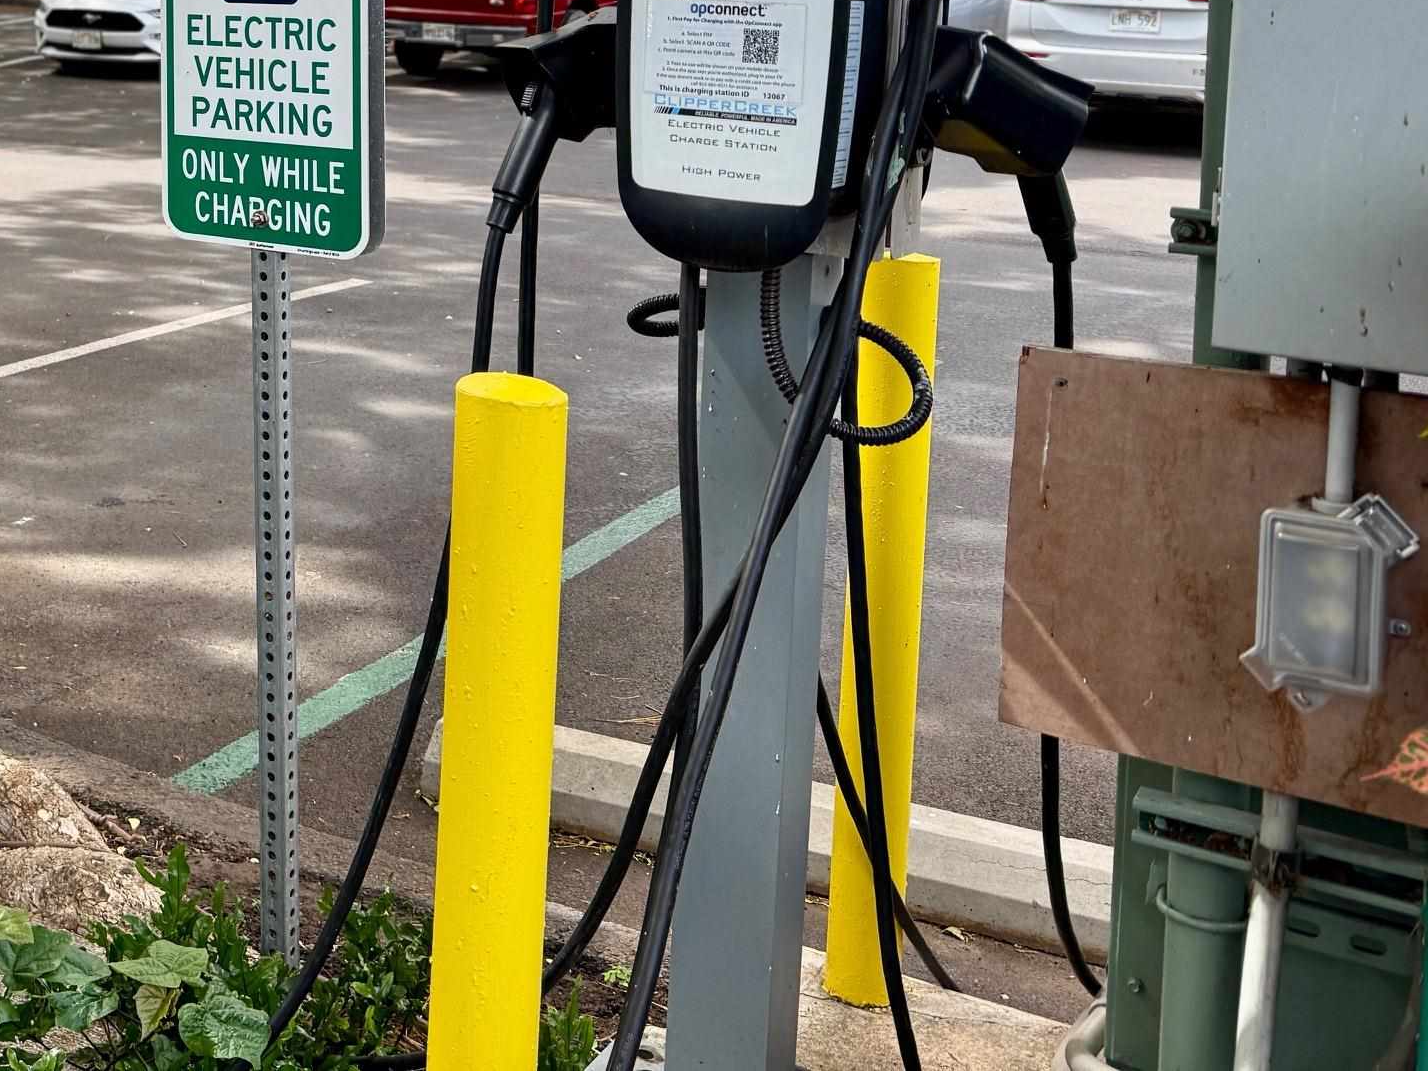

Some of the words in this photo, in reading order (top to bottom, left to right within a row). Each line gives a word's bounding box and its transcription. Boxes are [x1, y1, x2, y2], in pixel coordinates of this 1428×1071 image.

[690, 3, 766, 17] opconnect
[187, 14, 337, 52] ELECTRIC
[194, 55, 330, 95] VEHICLE
[682, 86, 713, 96] charging
[192, 96, 333, 138] PARKING
[182, 148, 250, 185] ONLY
[260, 155, 345, 194] WHILE
[195, 191, 331, 237] CHARGING
